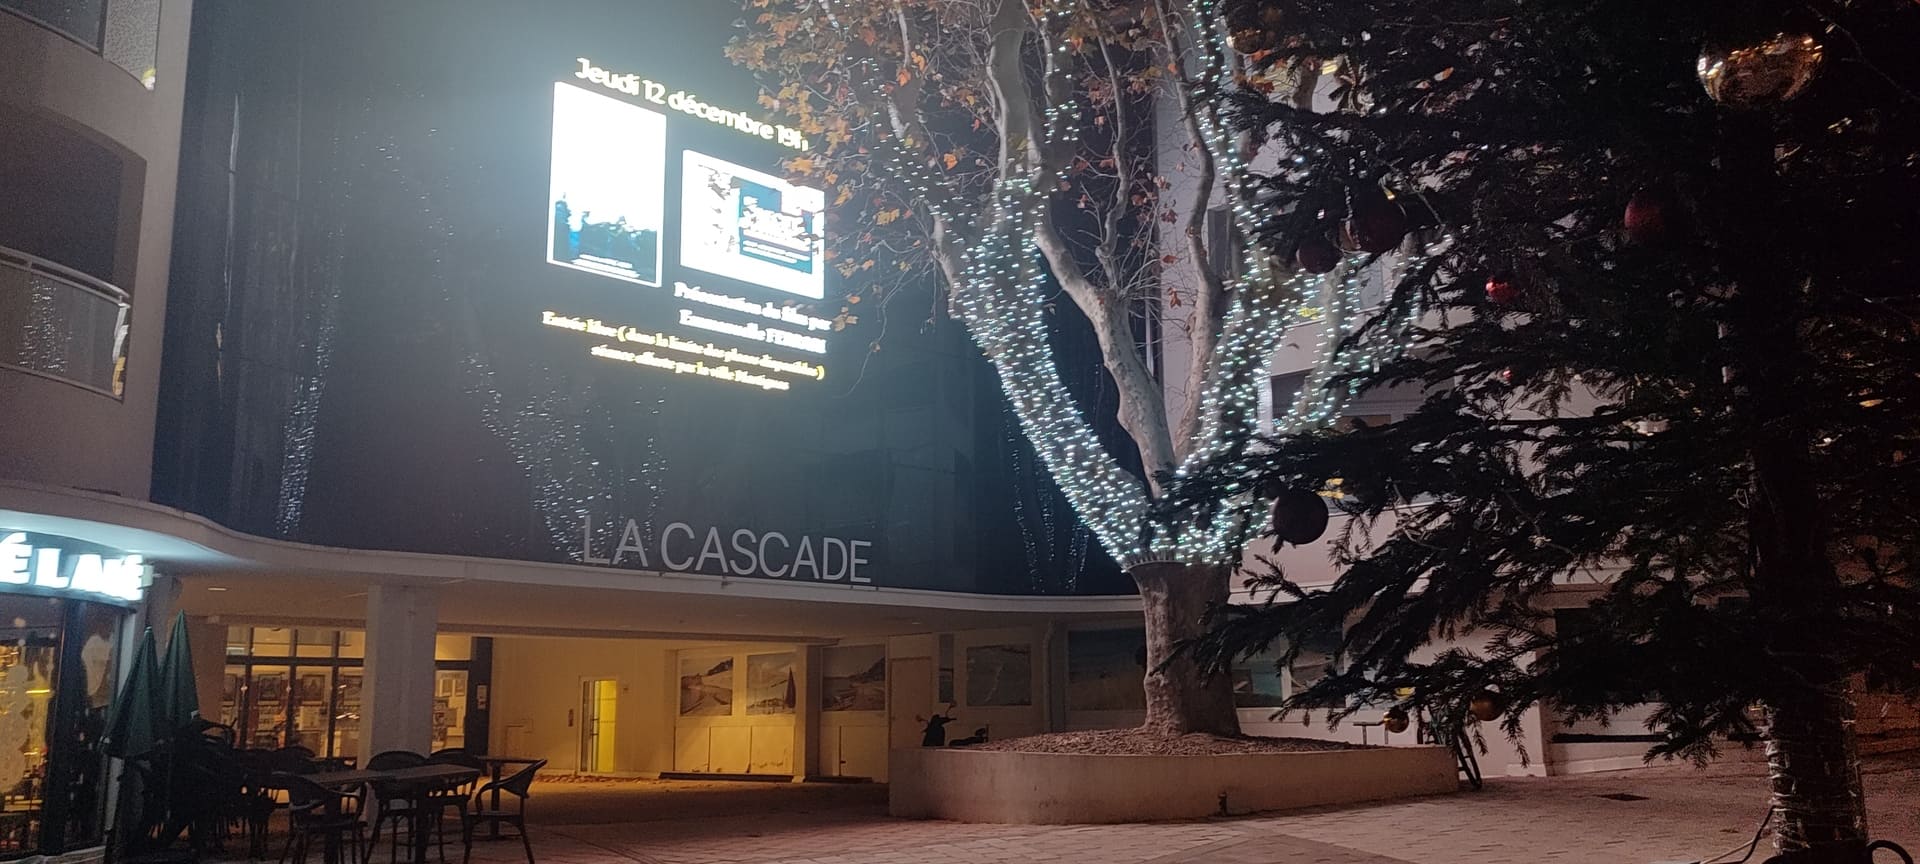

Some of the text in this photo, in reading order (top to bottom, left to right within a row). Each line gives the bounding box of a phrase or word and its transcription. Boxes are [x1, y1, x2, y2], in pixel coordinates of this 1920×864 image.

[575, 58, 639, 95] Jeudi
[643, 80, 666, 104] 12
[668, 91, 773, 139] décembre
[583, 514, 873, 583] LA CASCADE
